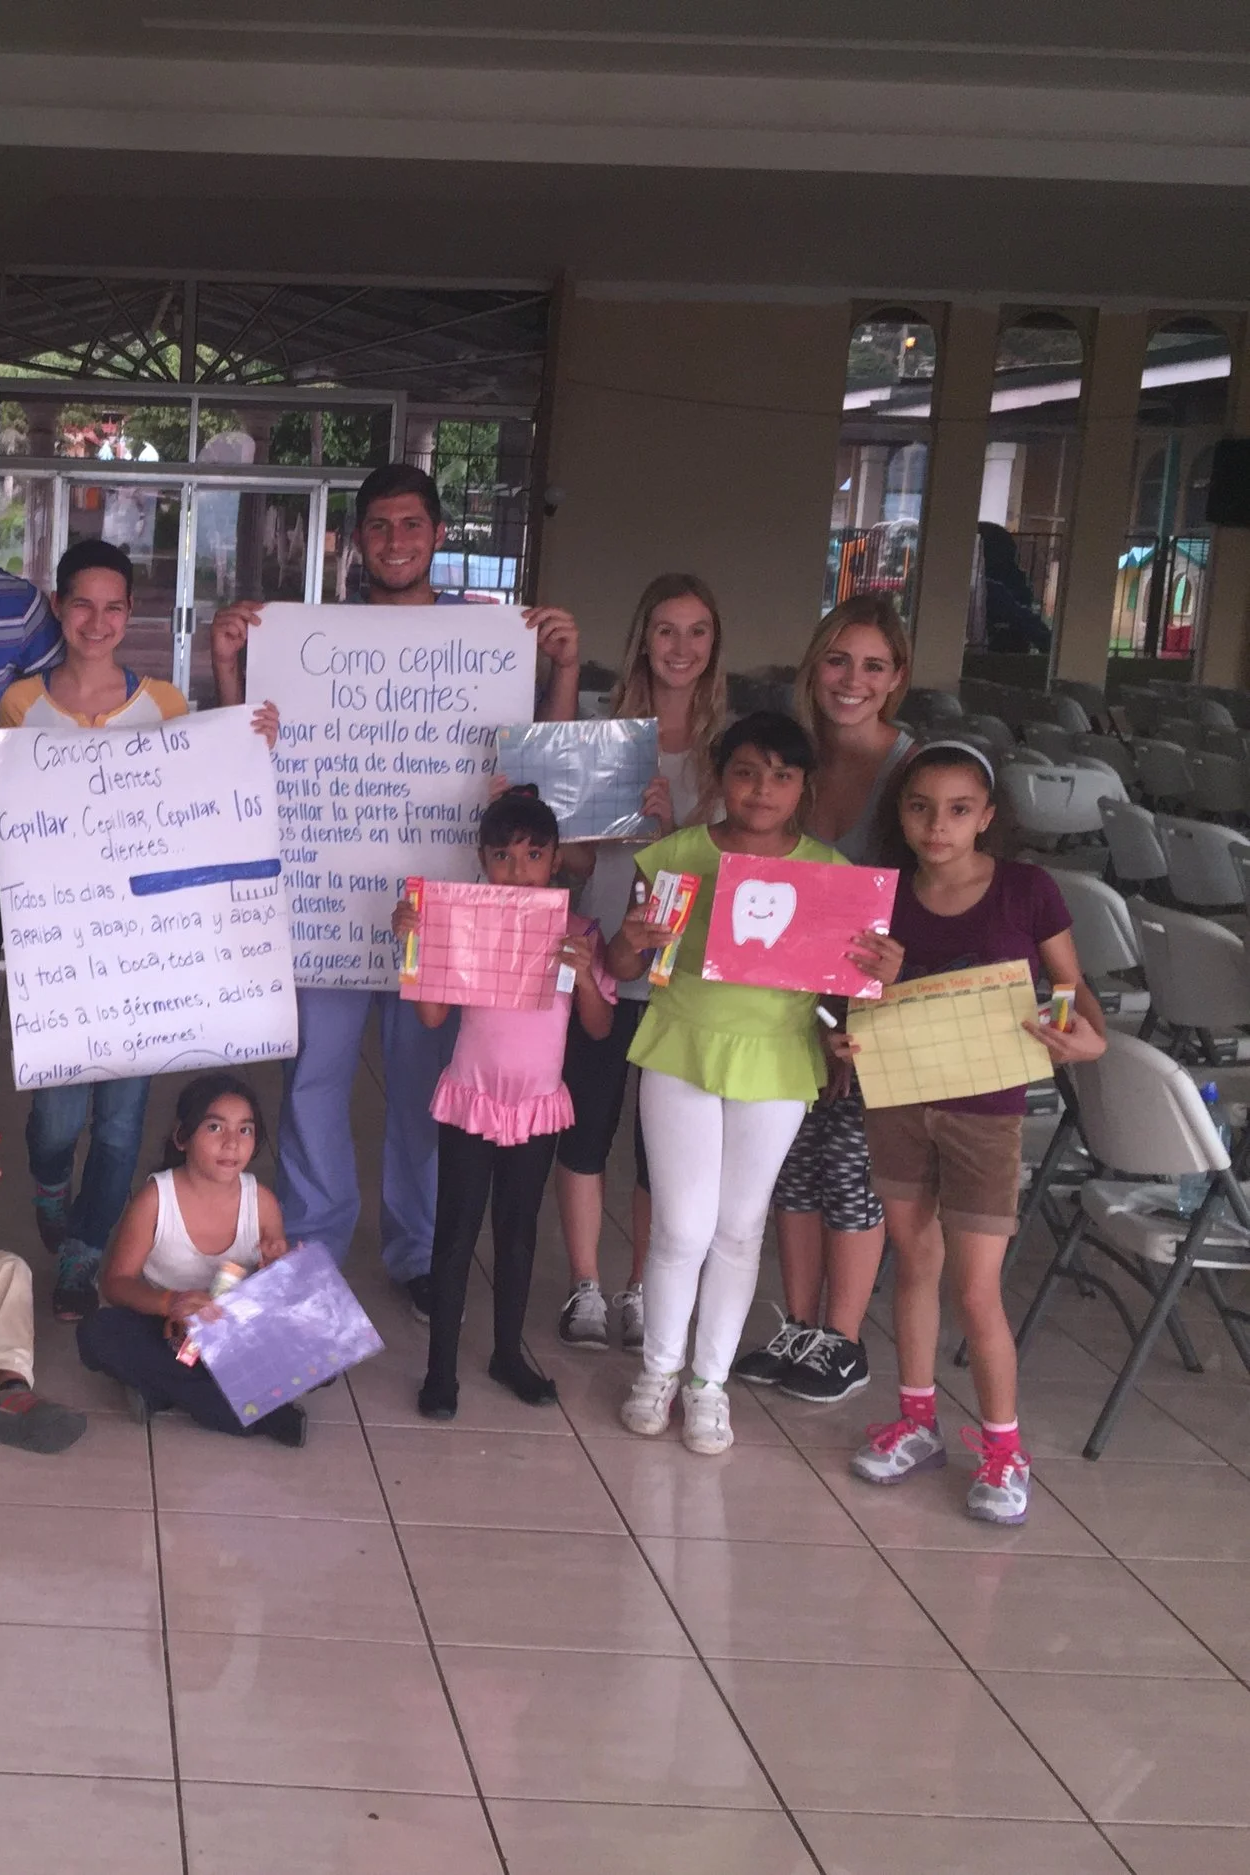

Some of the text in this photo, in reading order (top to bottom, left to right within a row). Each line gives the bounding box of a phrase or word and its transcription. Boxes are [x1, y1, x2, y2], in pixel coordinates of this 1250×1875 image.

[399, 637, 518, 682] cepillarse
[330, 678, 478, 713] los dientes:
[324, 717, 341, 742] el
[348, 719, 409, 746] cepillo
[414, 720, 439, 743] de
[33, 727, 191, 771] Canción de los
[314, 752, 359, 780] pasta
[365, 750, 387, 772] de
[393, 751, 451, 775] dientes
[455, 757, 476, 775] en
[481, 755, 498, 777] el
[88, 765, 163, 796] dientes
[330, 776, 350, 797] de
[355, 775, 411, 798] dientes
[233, 789, 263, 823] los
[277, 802, 323, 825] epillar
[332, 801, 349, 821] la
[355, 803, 398, 823] parte
[404, 800, 461, 826] frontal
[301, 824, 362, 843] dientes
[369, 829, 389, 844] en
[398, 825, 422, 845] un
[328, 869, 343, 889] la
[349, 874, 389, 893] parte
[0, 880, 47, 913] Todos
[52, 882, 76, 906] los
[291, 894, 347, 914] dientes
[73, 926, 85, 949] y
[91, 917, 146, 940] abajo,
[150, 910, 203, 933] arriba
[212, 913, 224, 934] y
[349, 920, 364, 942] la
[14, 971, 30, 1001] y
[35, 962, 77, 987] toda
[88, 954, 108, 979] la
[168, 946, 206, 969] toda
[214, 945, 232, 963] la
[368, 950, 385, 970] la
[14, 1008, 70, 1039] Adiós
[75, 1006, 92, 1026] a
[96, 1003, 119, 1023] los
[218, 978, 265, 1005] adiós
[269, 978, 284, 994] a
[87, 1035, 113, 1062] los
